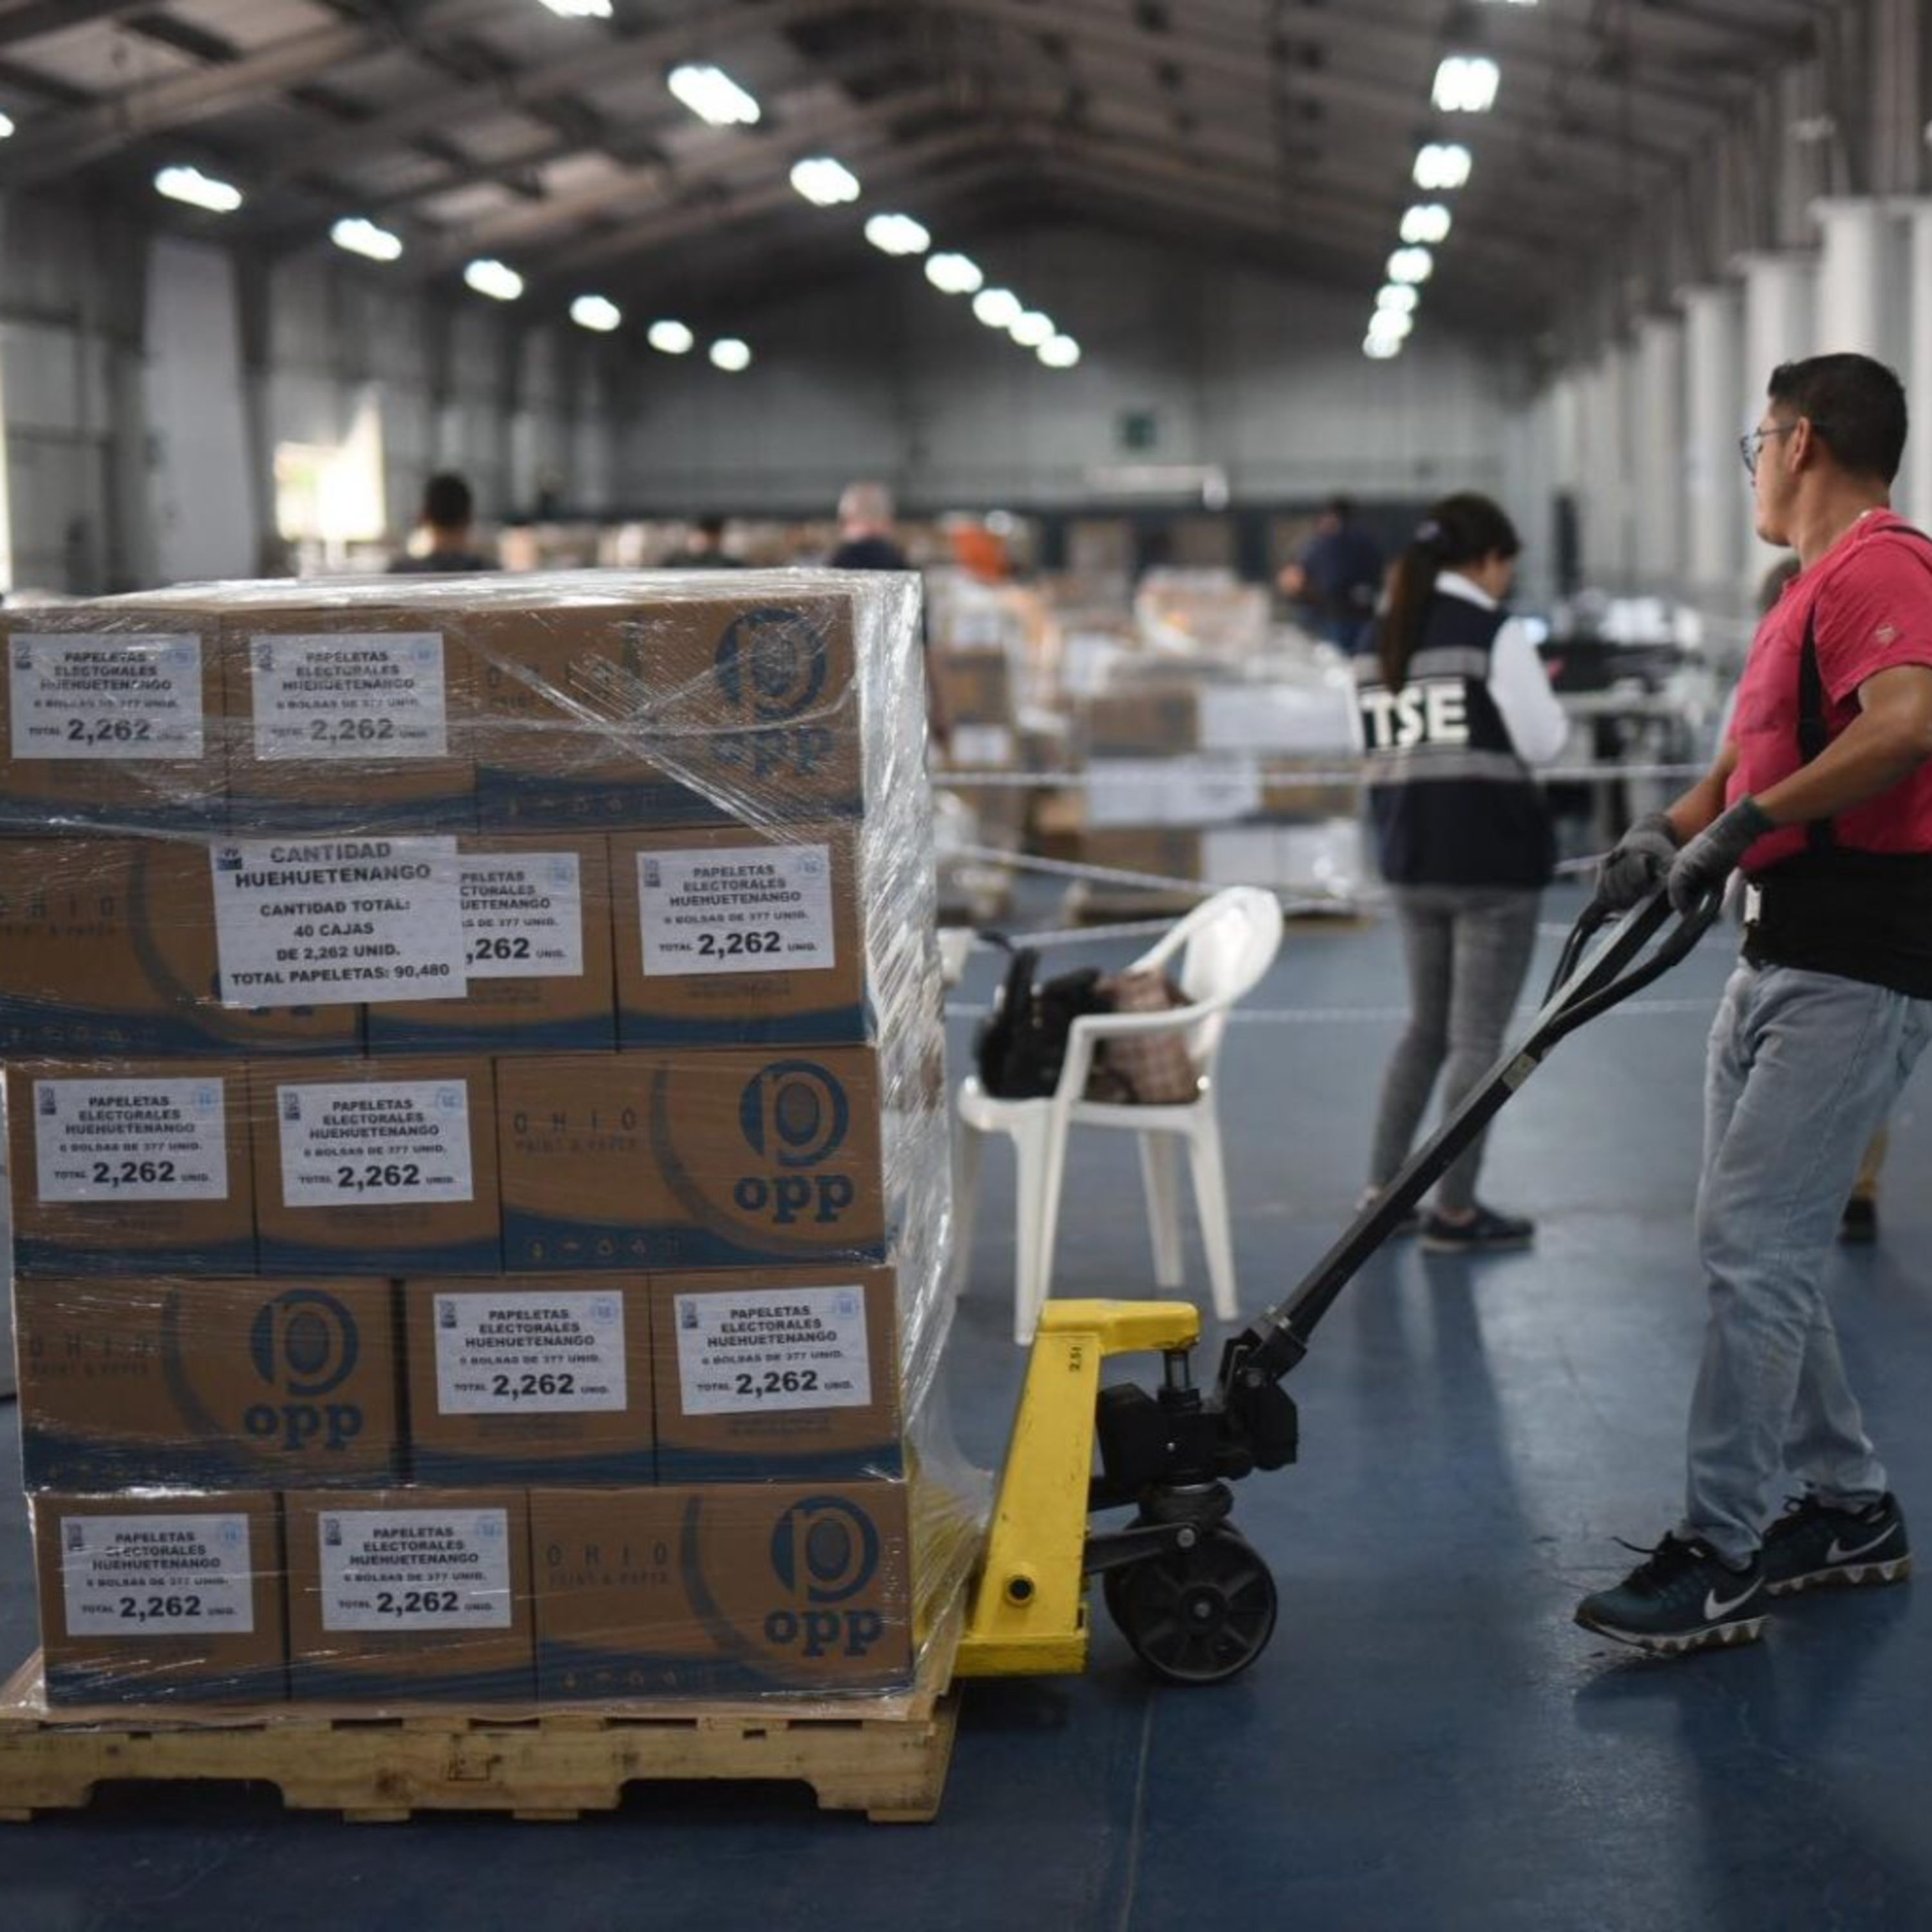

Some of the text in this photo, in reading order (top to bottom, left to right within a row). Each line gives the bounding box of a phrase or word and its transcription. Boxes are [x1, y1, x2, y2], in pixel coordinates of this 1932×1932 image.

[1358, 684, 1469, 748] TSE
[68, 719, 150, 744] 2,262
[310, 718, 394, 744] 2,262
[270, 842, 391, 863] CANTIDAD
[235, 864, 430, 888] HUEHUETENANGO
[461, 871, 524, 882] PELETAS
[694, 864, 775, 877] PAPELETAS
[460, 885, 535, 896] CTORALES
[683, 878, 786, 892] ELECTORALES
[461, 898, 551, 910] UETENANGO
[670, 891, 801, 907] HUEHUETENANGO
[260, 900, 410, 916] CANTIDAD TOTAL:
[294, 923, 374, 937] 40 CAJAS
[466, 938, 530, 965] ,262
[697, 931, 781, 958] 2,262
[276, 945, 400, 961] DE 2,262 UNID.
[232, 963, 450, 985] TOTAL PAPELETAS: 90,480
[89, 1096, 170, 1107] PAPELETAS
[332, 1099, 413, 1111] PAPELETAS
[79, 1110, 181, 1122] ELECTORALES
[323, 1113, 424, 1125] ELECTORALES
[514, 1108, 636, 1133] OHIO
[66, 1123, 194, 1135] HUEHUETENANGO
[310, 1124, 439, 1139] HUEHUETENANGO
[93, 1162, 175, 1188] 2,262
[337, 1164, 421, 1191] 2,262
[734, 1175, 855, 1223] opp
[489, 1309, 569, 1320] PAPELETAS
[730, 1305, 810, 1319] PAPELETAS
[479, 1323, 580, 1334] ELECTORALES
[721, 1318, 822, 1333] ELECTORALES
[466, 1336, 594, 1347] HUEHUETENANGO
[708, 1331, 837, 1347] HUEHUETENANGO
[493, 1374, 574, 1401] 2,262
[735, 1370, 819, 1398] 2,262
[243, 1404, 363, 1450] opp
[115, 1532, 195, 1543] PAPELETAS
[373, 1528, 454, 1539] PAPELETAS
[363, 1540, 465, 1552] ELECTORALES
[350, 1553, 478, 1565] HUEHUETENANGO
[547, 1543, 668, 1566] OHIO
[93, 1558, 221, 1571] HUEHUETENANGO
[120, 1596, 201, 1622] 2,262
[377, 1592, 459, 1617] 2,262
[764, 1610, 884, 1657] opp
